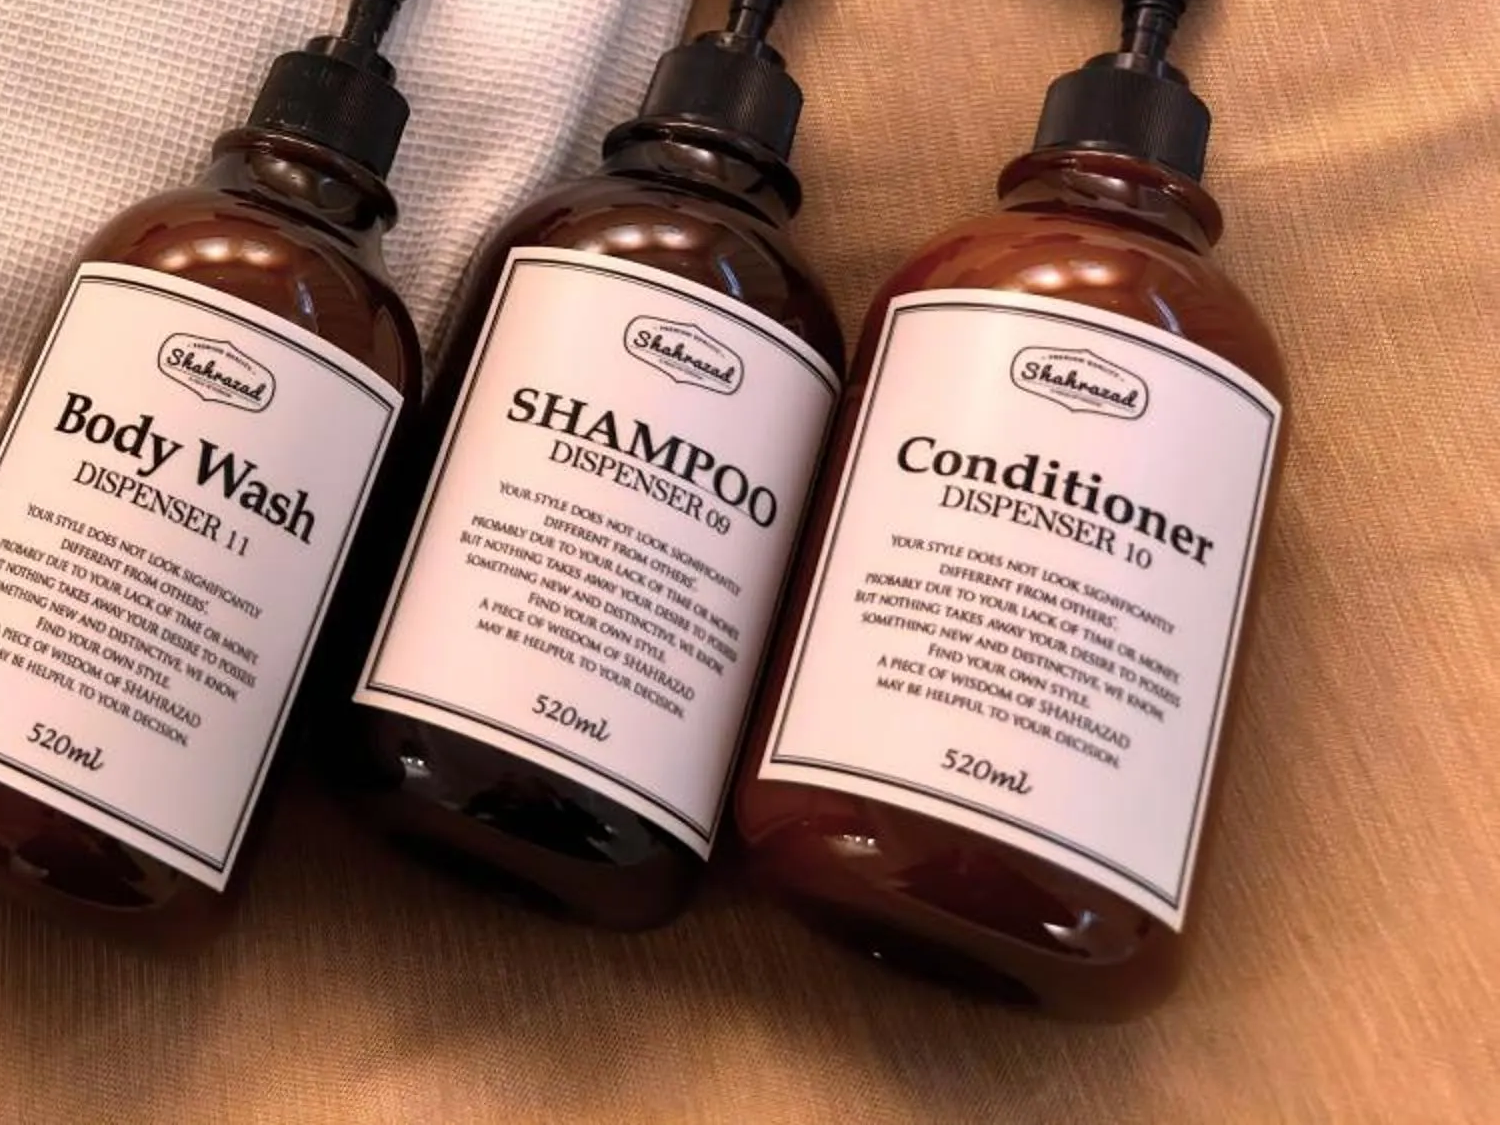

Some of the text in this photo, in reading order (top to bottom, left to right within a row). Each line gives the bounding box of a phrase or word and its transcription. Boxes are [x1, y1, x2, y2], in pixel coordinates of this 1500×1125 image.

[166, 347, 267, 402] Shahrazad
[632, 330, 736, 384] Shahrazad
[1020, 361, 1139, 409] Shahrazad
[54, 391, 315, 545] Body Wash
[506, 387, 777, 528] SHAMPOO
[548, 439, 732, 536] DISPENSER 09
[72, 460, 250, 557] DISPENSER 11
[897, 436, 1214, 566] Conditioner
[939, 484, 1153, 570] DISPENSER 10
[26, 722, 104, 772] 520ml
[531, 694, 611, 743] 520ml
[940, 748, 1033, 796] 520ml
